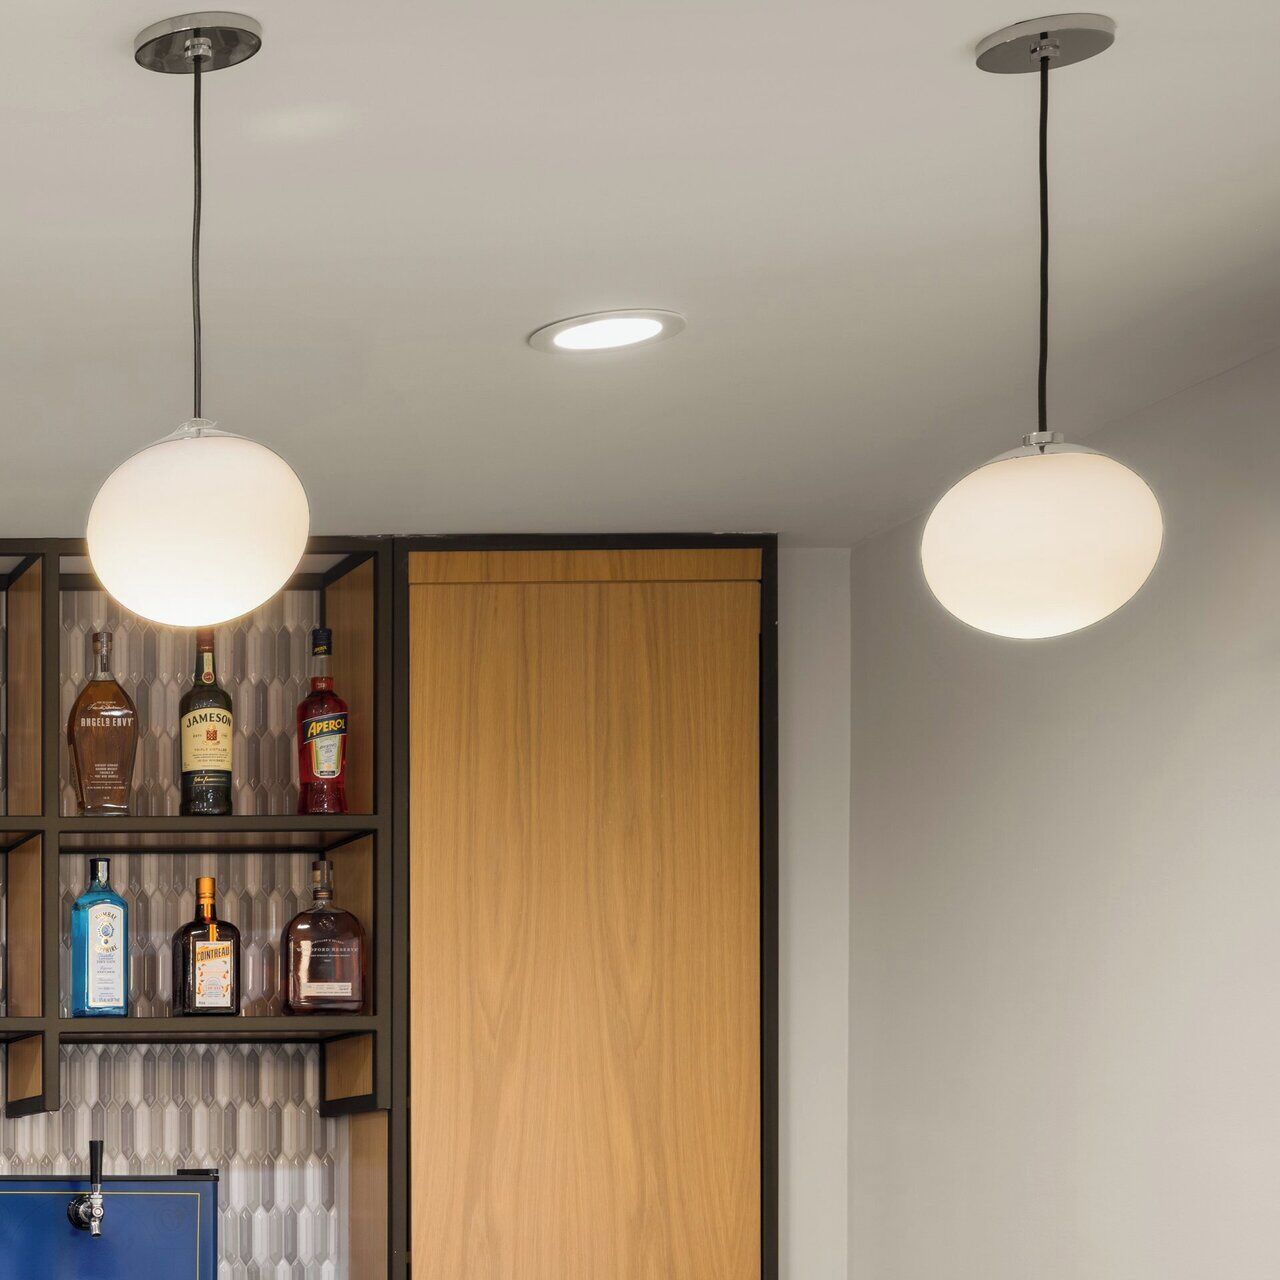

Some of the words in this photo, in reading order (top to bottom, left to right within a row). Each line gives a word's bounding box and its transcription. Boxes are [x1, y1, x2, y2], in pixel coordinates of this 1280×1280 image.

[112, 717, 132, 727] ENVY
[186, 712, 232, 728] JAMESON
[308, 718, 345, 738] APEROL
[196, 945, 230, 962] COINTREAU
